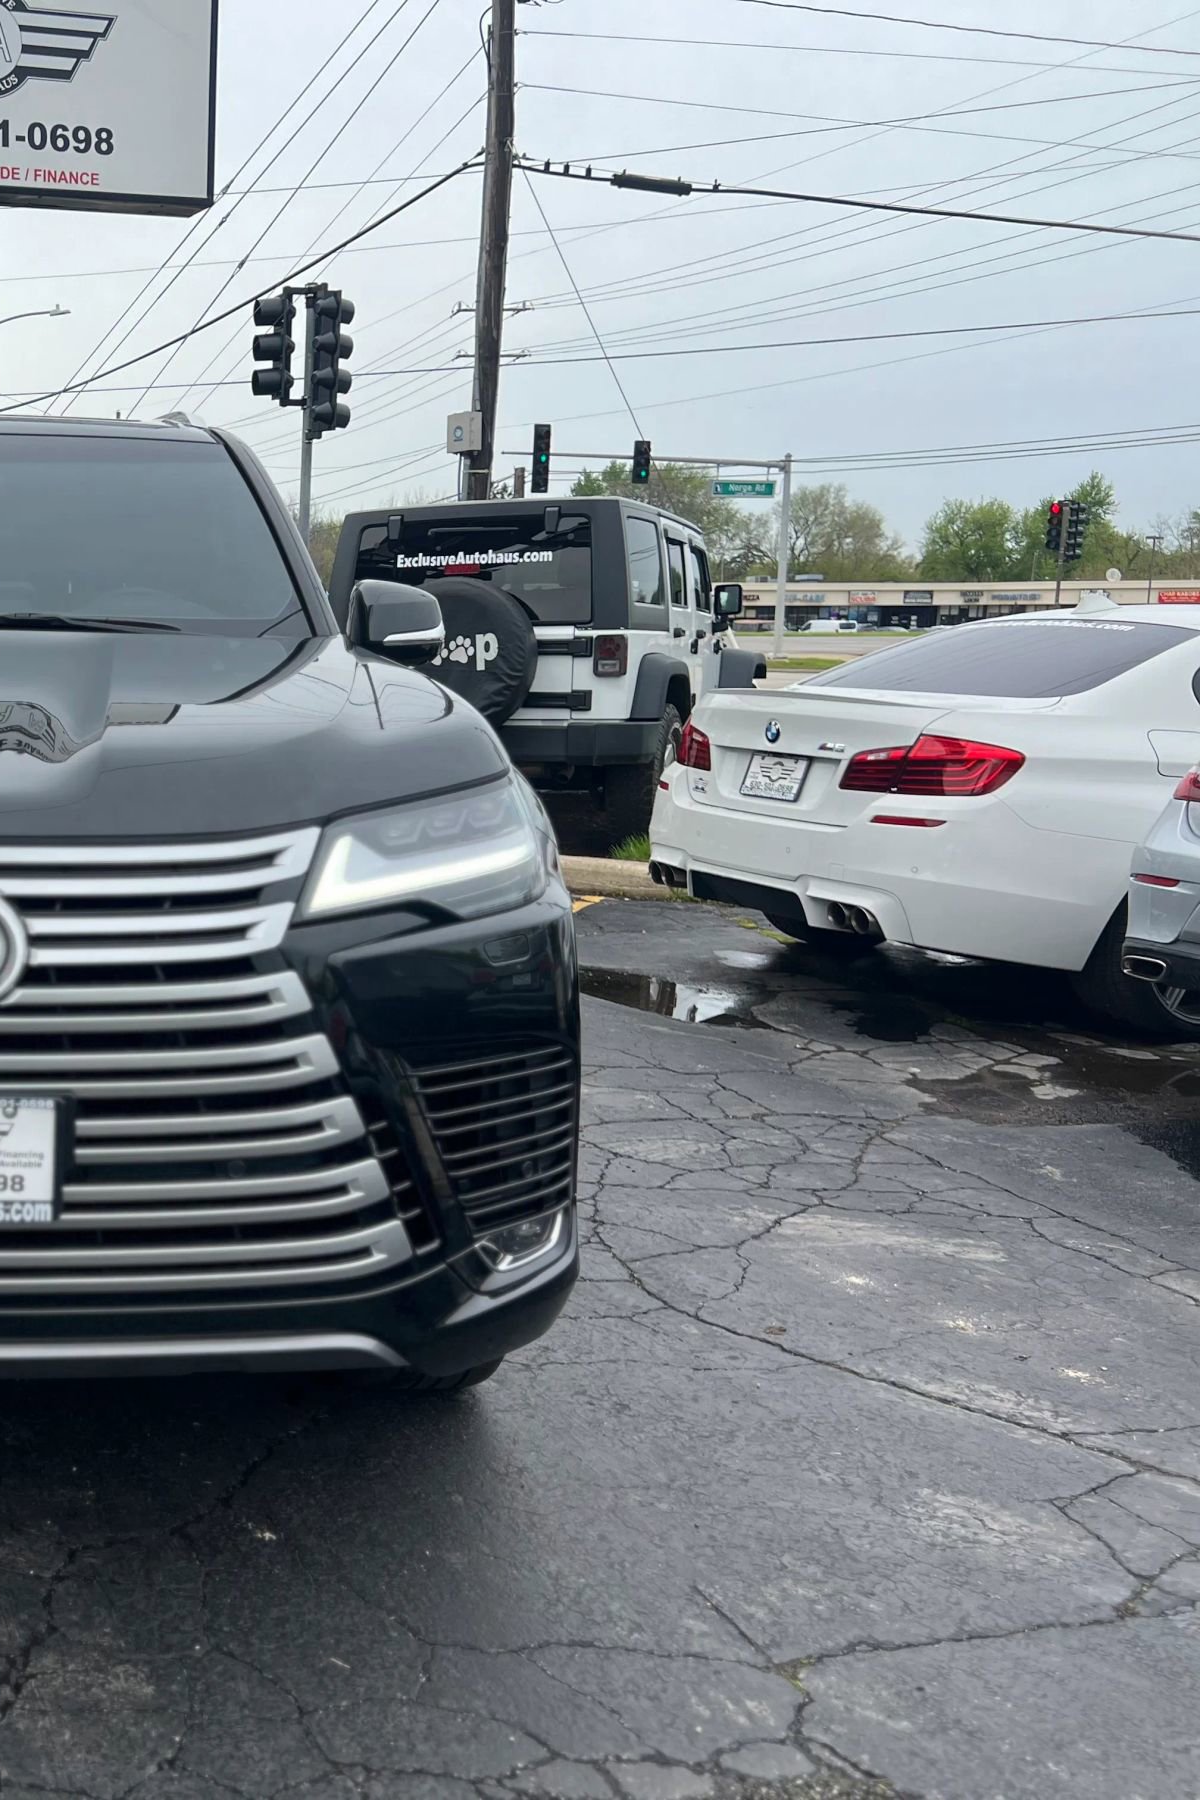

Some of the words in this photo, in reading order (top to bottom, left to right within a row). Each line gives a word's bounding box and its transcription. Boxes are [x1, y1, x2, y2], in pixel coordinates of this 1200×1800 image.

[33, 169, 100, 186] FINANCE
[755, 483, 766, 492] Rd
[396, 549, 553, 568] ExclusiveAutohaus.com
